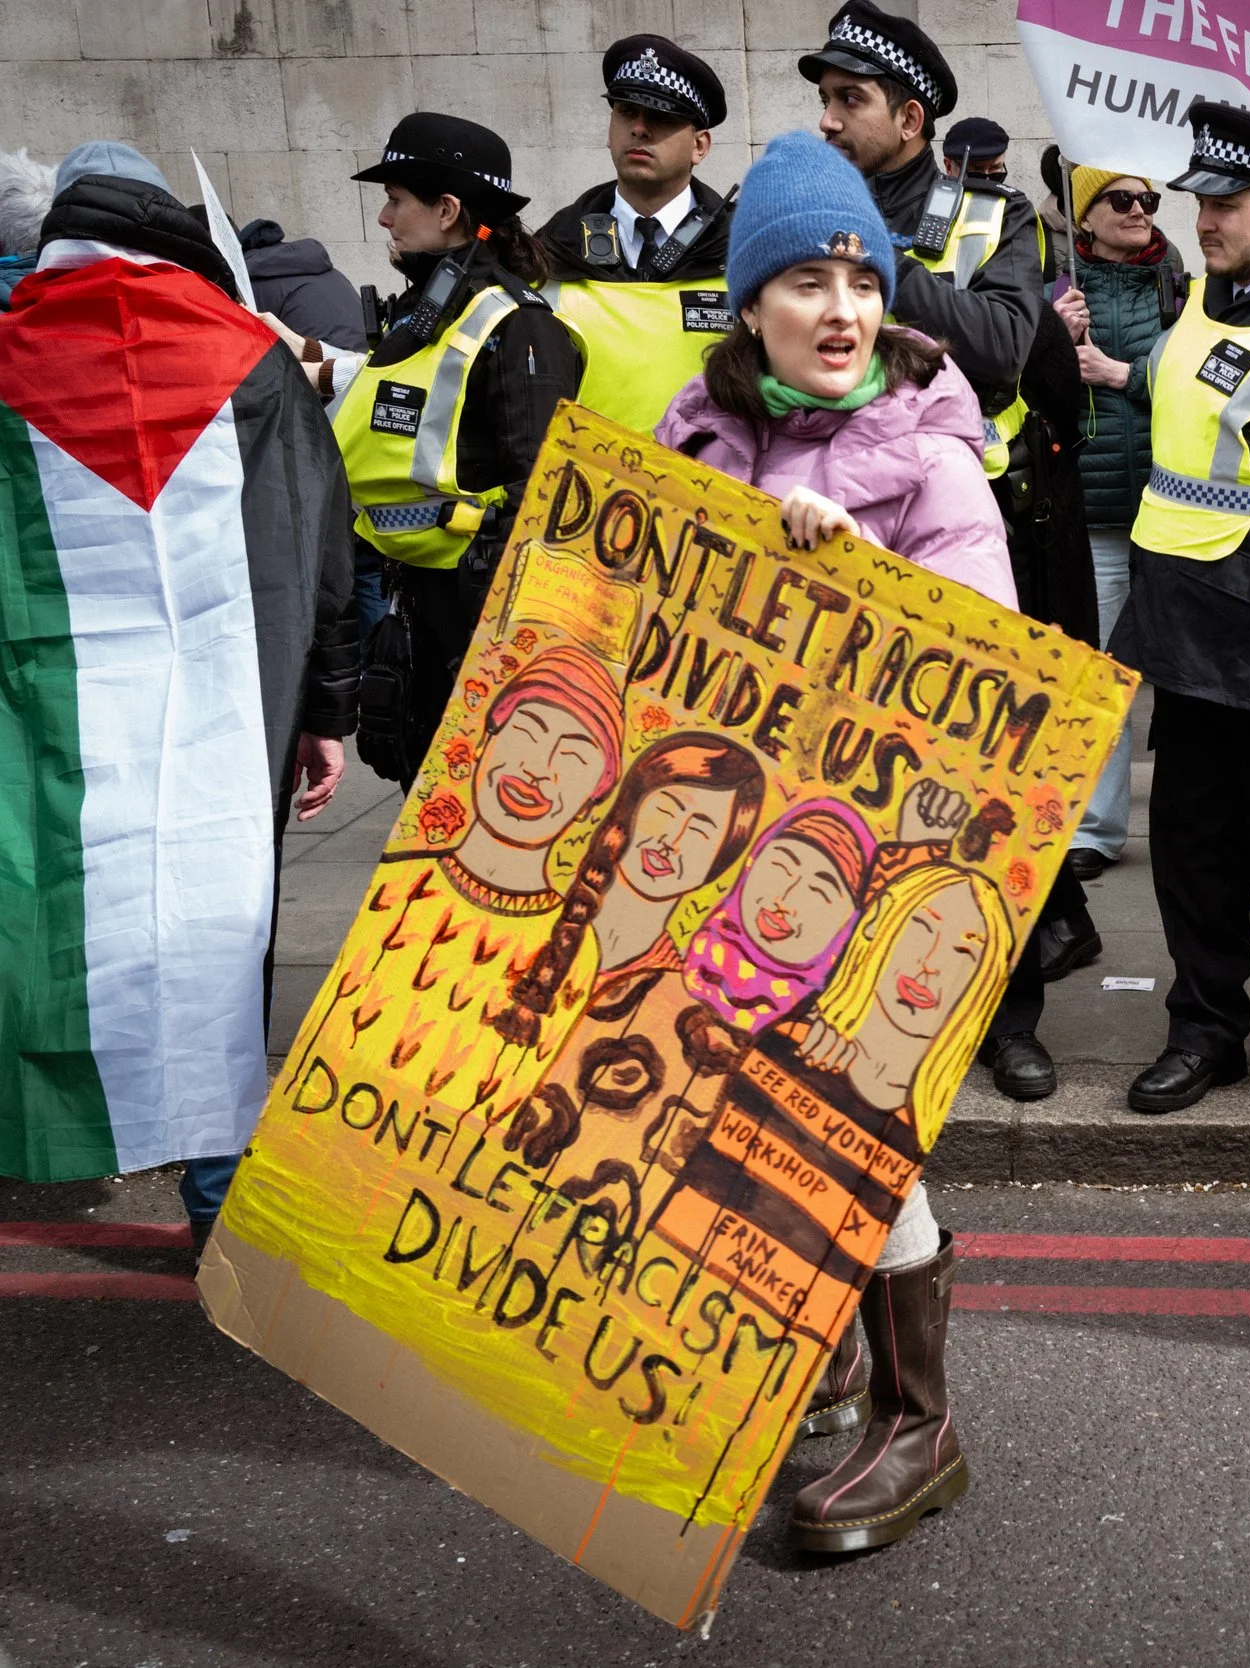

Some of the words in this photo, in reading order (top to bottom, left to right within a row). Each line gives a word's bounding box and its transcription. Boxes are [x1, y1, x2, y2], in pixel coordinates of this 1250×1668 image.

[686, 321, 709, 329] POLICE
[709, 322, 735, 331] OFFICER
[1200, 369, 1217, 382] POLICE
[1219, 367, 1236, 381] POLICE
[373, 419, 392, 429] POLICE
[392, 422, 416, 432] OFFICER
[391, 412, 411, 422] POLICE
[527, 575, 549, 590] THE
[716, 549, 852, 670] LET
[827, 606, 1052, 778] RACISM
[626, 609, 807, 762] DIVIDE
[822, 717, 923, 811] US
[749, 1060, 786, 1094] SEE
[784, 1089, 820, 1121] RED
[720, 1113, 829, 1197] WORKSHOP
[714, 1213, 779, 1264] ERIN
[383, 1188, 587, 1365] DIVIDE
[450, 1136, 578, 1234] LET
[552, 1196, 799, 1402] RACISM
